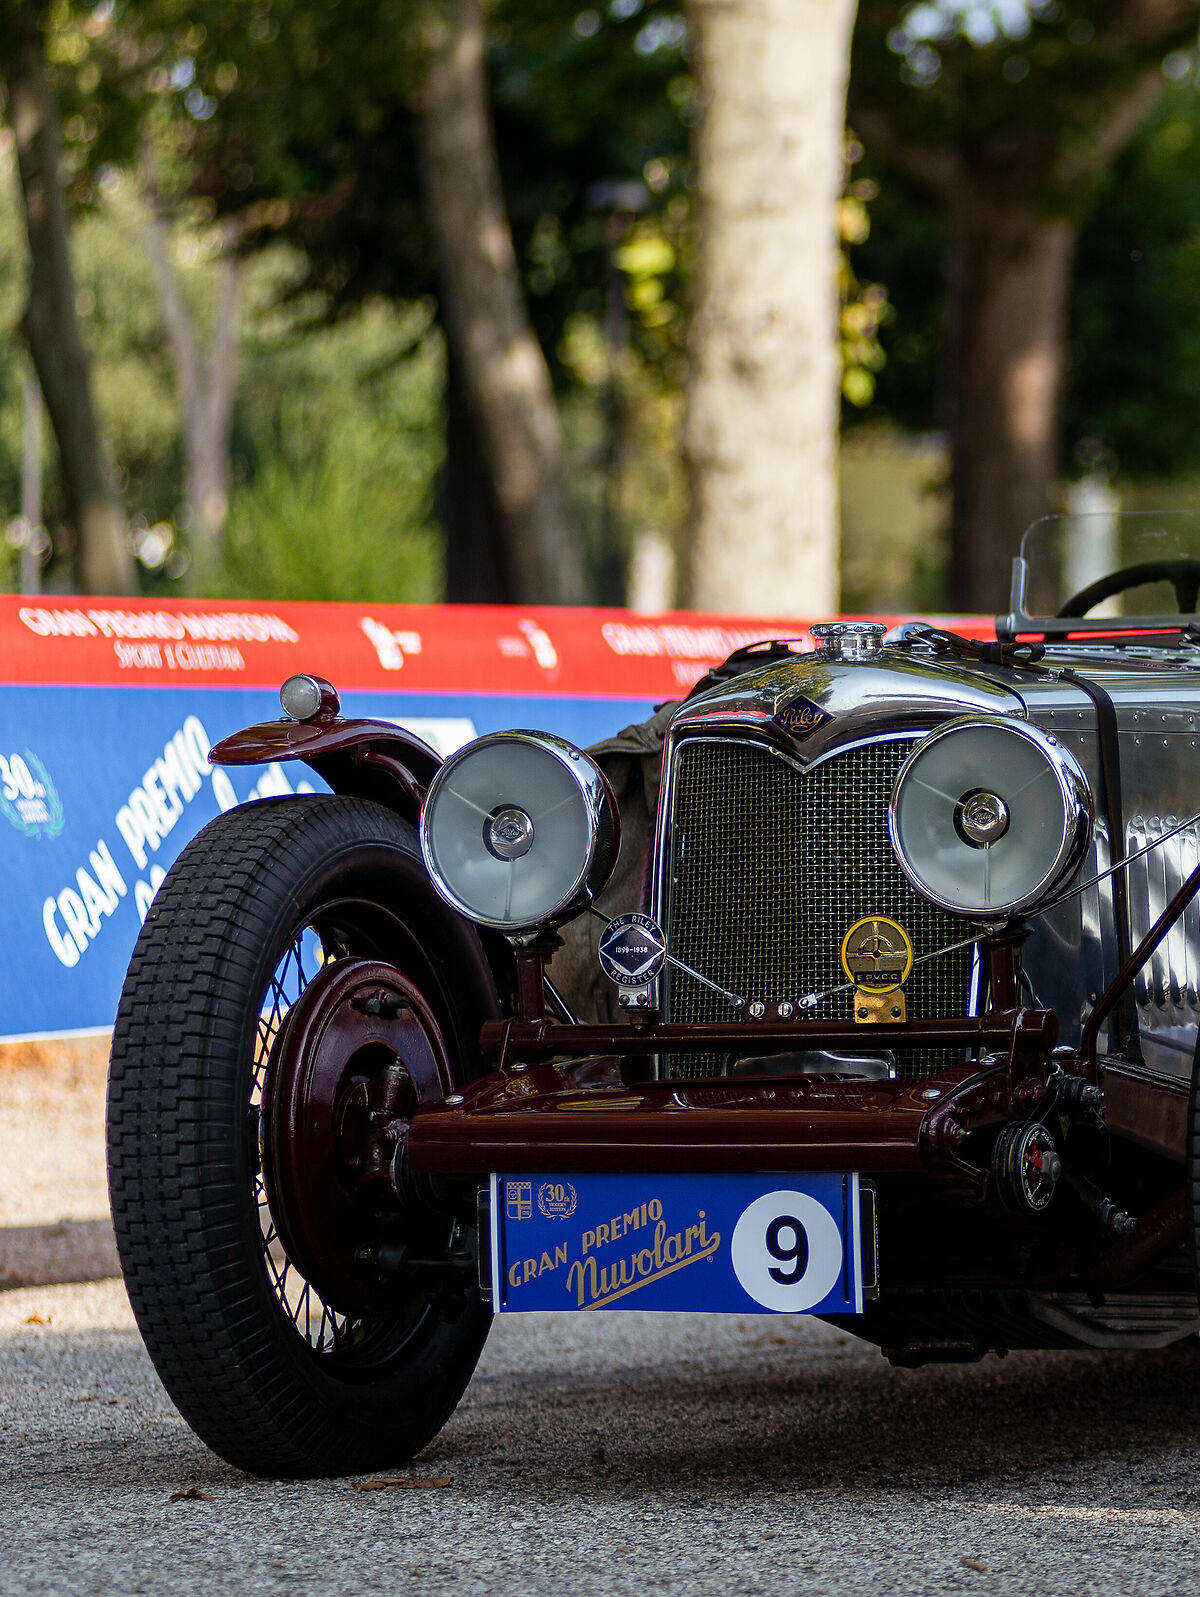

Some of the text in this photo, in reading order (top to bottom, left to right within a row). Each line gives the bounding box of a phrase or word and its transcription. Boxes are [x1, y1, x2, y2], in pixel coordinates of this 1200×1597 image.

[780, 707, 824, 733] Riley
[42, 714, 214, 968] GRAN PREMIO
[608, 915, 657, 932] THE RILEY
[610, 969, 655, 985] REGISTER
[508, 1198, 663, 1288] GRAN PREMIO
[566, 1210, 722, 1310] Nuvolari
[764, 1215, 810, 1286] 9
